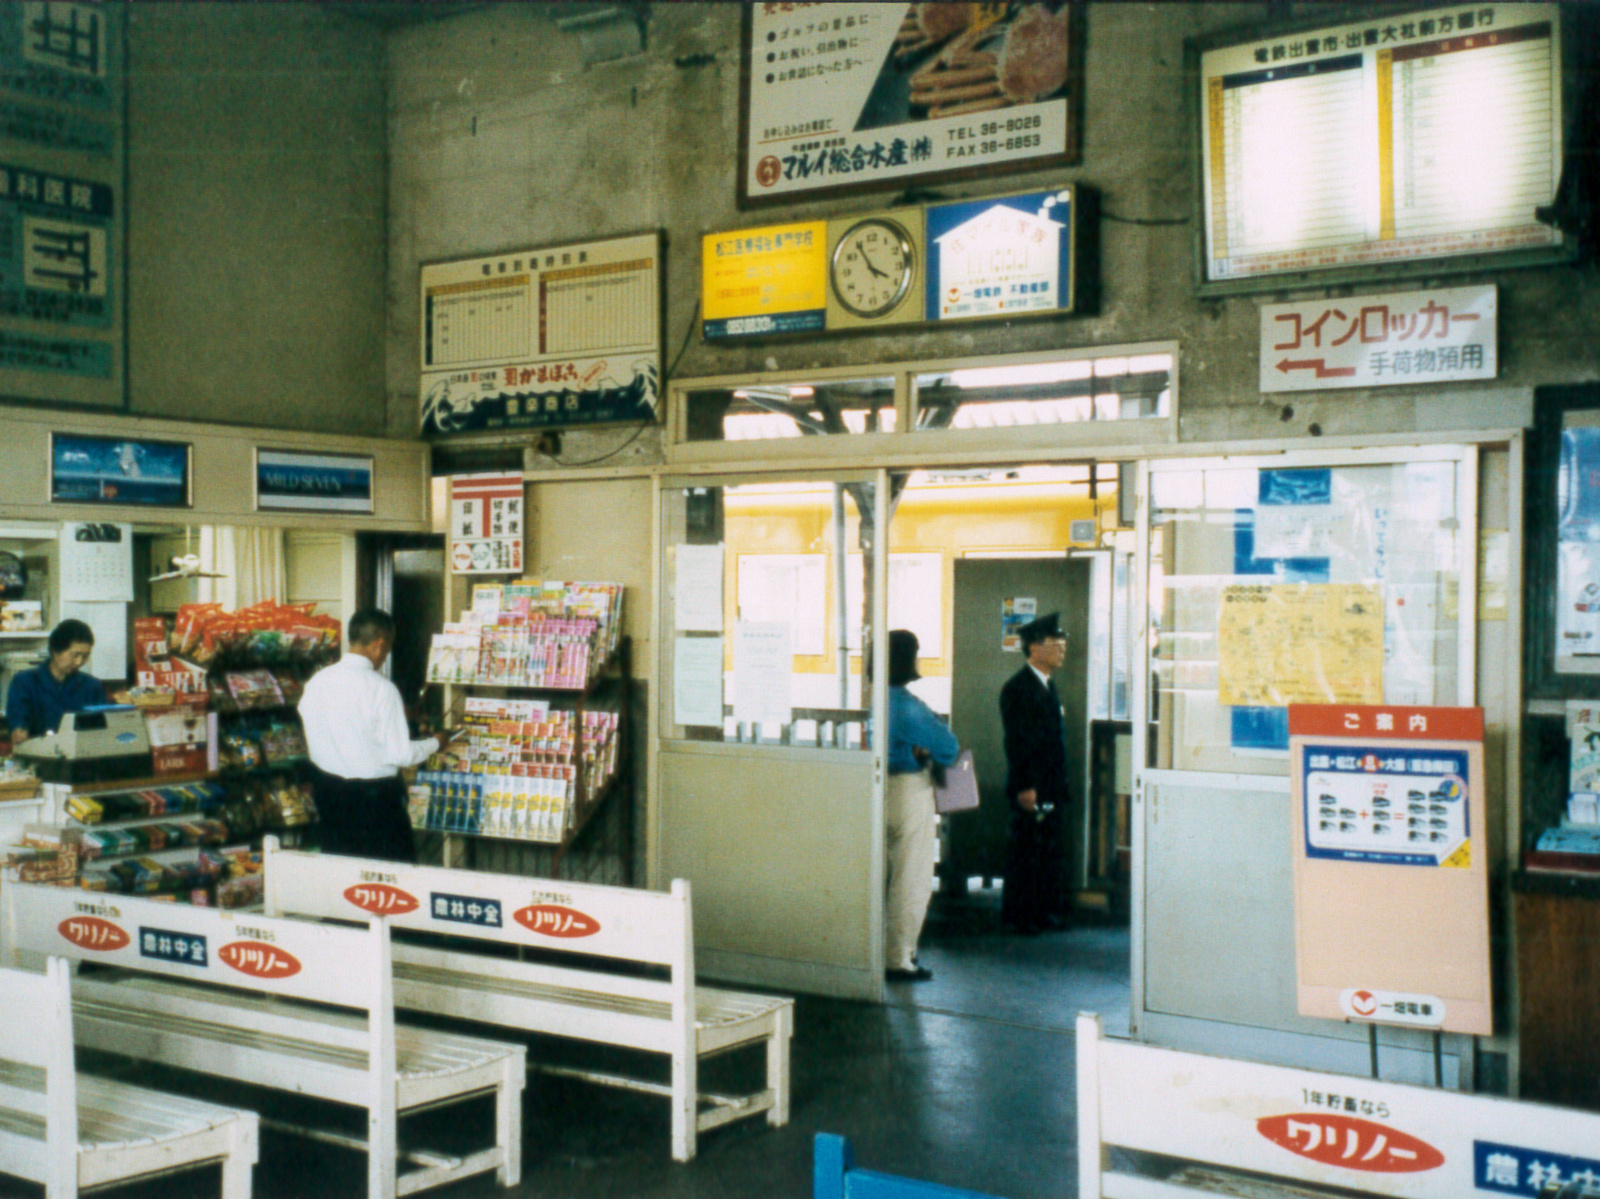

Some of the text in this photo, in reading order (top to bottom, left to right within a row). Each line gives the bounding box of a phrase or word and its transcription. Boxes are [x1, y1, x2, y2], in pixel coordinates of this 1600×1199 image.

[947, 127, 975, 140] TEL
[946, 144, 975, 158] FAX
[1274, 300, 1481, 351] コインロッカー
[1370, 344, 1483, 376] 手荷物預用
[265, 471, 341, 491] MILD SEVEN
[1344, 713, 1427, 732] ご案内
[160, 757, 186, 770] LARK
[354, 888, 409, 908] ワリノー
[434, 898, 499, 924] 農林中金
[526, 910, 587, 932] リツノー
[69, 921, 121, 944] ワリノー
[143, 932, 205, 962] 農林中金
[230, 946, 289, 972] リツノー
[1380, 1001, 1433, 1016] 一畑電車
[1302, 1088, 1391, 1119] 1年貯蓄なら
[1286, 1118, 1418, 1162] ワリノー
